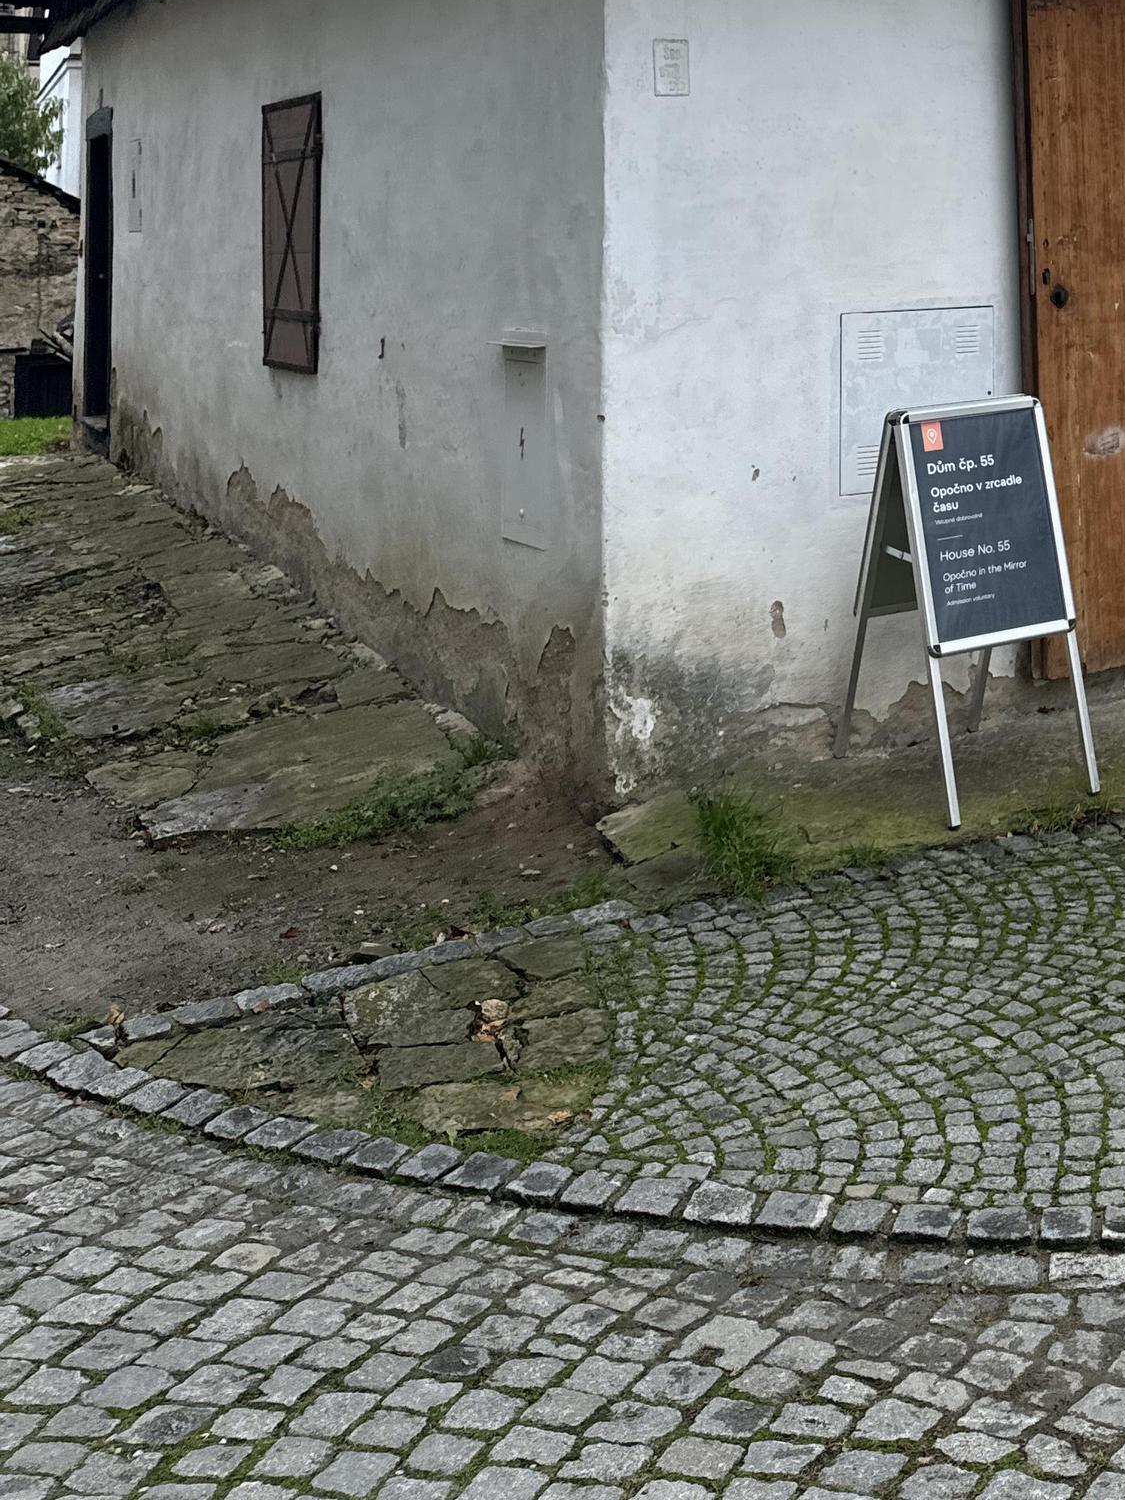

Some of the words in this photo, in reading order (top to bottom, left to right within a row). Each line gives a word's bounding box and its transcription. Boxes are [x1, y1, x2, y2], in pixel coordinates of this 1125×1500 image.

[926, 460, 956, 475] Dům
[958, 457, 978, 472] čp.
[980, 454, 995, 467] 55
[930, 483, 974, 499] Opočno
[976, 483, 982, 491] v
[985, 475, 1022, 489] zrcadle
[932, 501, 959, 513] času
[940, 548, 975, 562] House
[977, 544, 996, 556] No.
[997, 540, 1011, 552] 55
[943, 570, 977, 582] Opočno
[988, 564, 1002, 574] the
[1003, 560, 1027, 571] Mirror
[944, 584, 954, 595] of
[956, 582, 977, 592] Time
